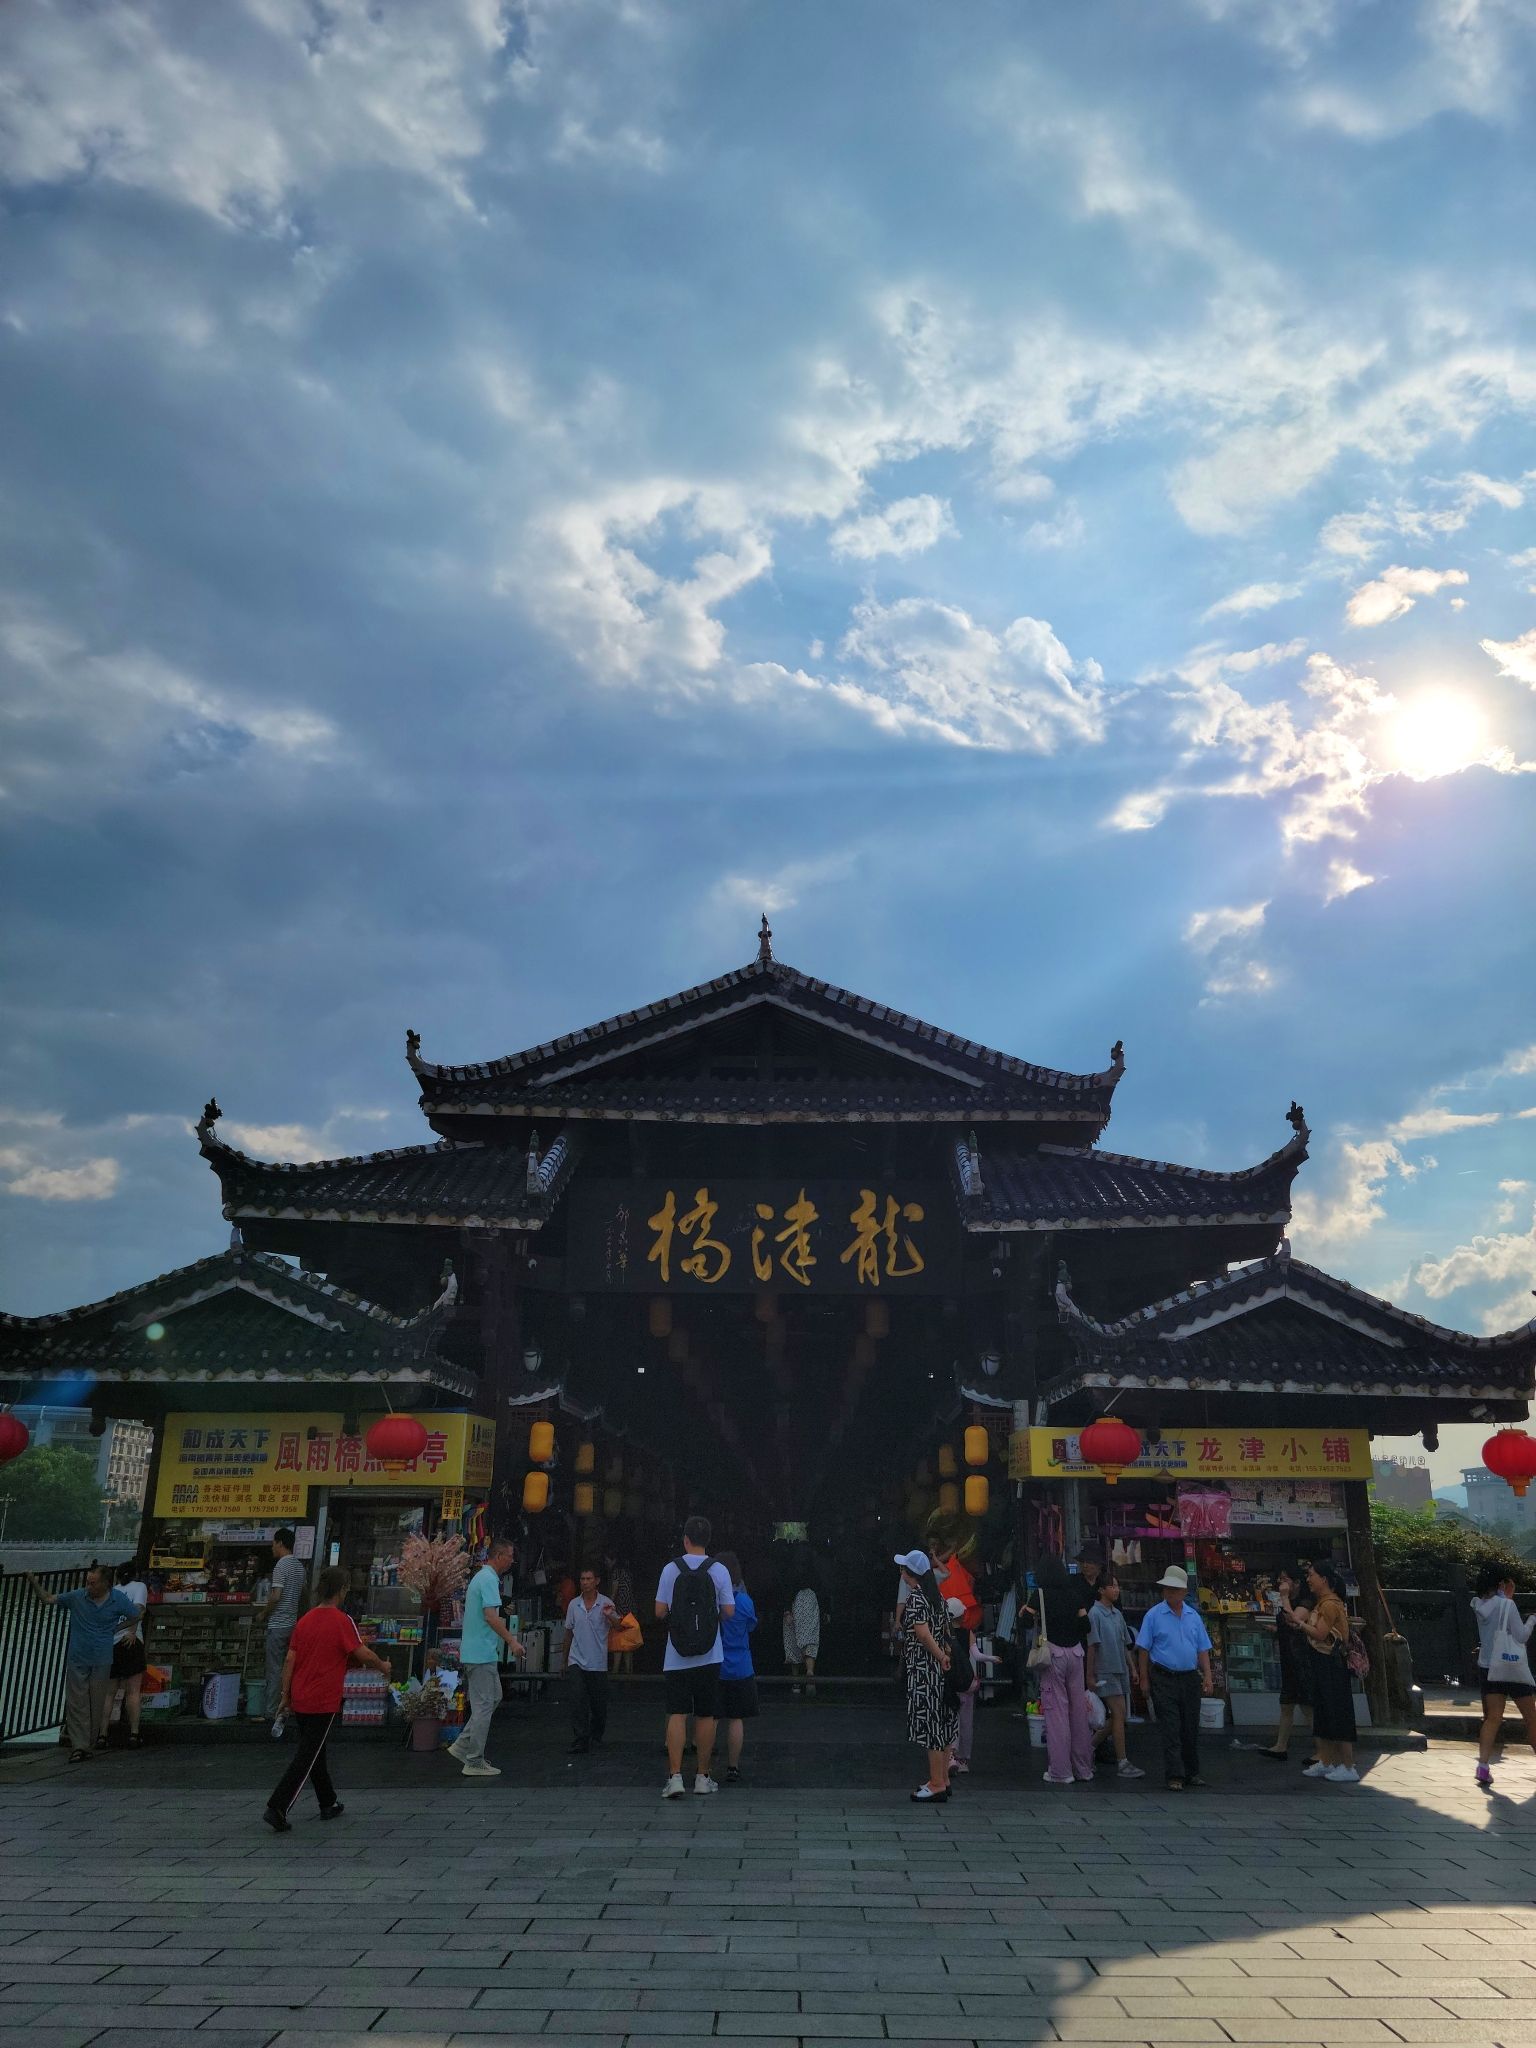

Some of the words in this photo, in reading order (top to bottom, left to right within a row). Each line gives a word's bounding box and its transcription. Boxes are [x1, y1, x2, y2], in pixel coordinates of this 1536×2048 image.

[182, 1428, 271, 1449] 和成天下
[1195, 1436, 1351, 1463] 龙津小铺
[274, 1431, 449, 1474] 風雨橋亭
